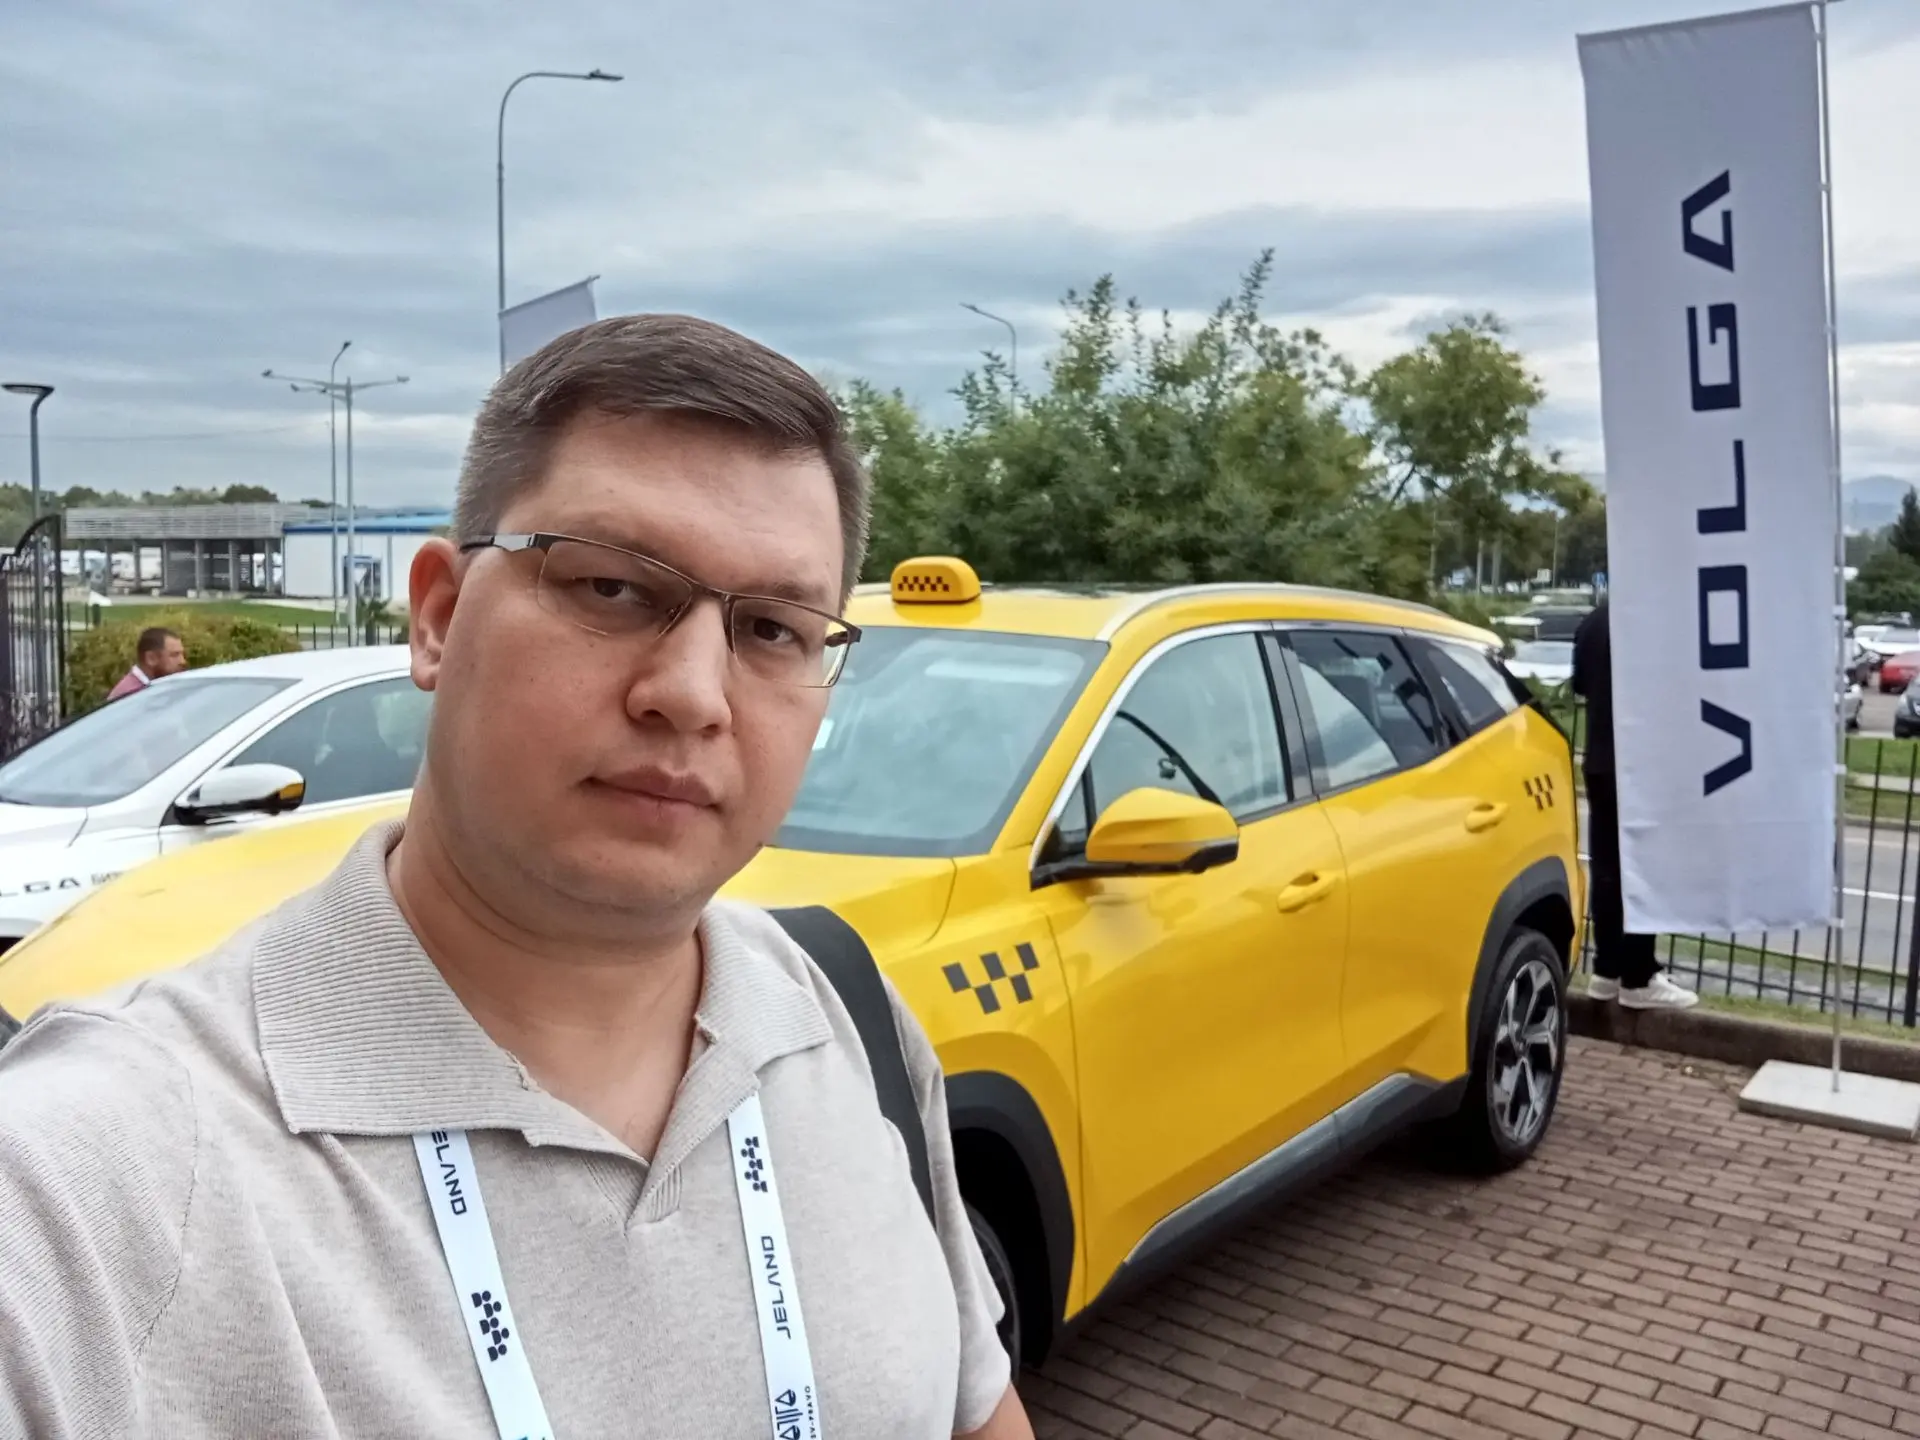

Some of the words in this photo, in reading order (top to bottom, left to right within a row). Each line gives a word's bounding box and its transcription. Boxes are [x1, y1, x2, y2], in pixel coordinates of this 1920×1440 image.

[1681, 169, 1752, 797] VOLGA
[0, 878, 81, 897] LGA
[431, 1129, 468, 1216] ELAND
[760, 1235, 792, 1340] JELAND
